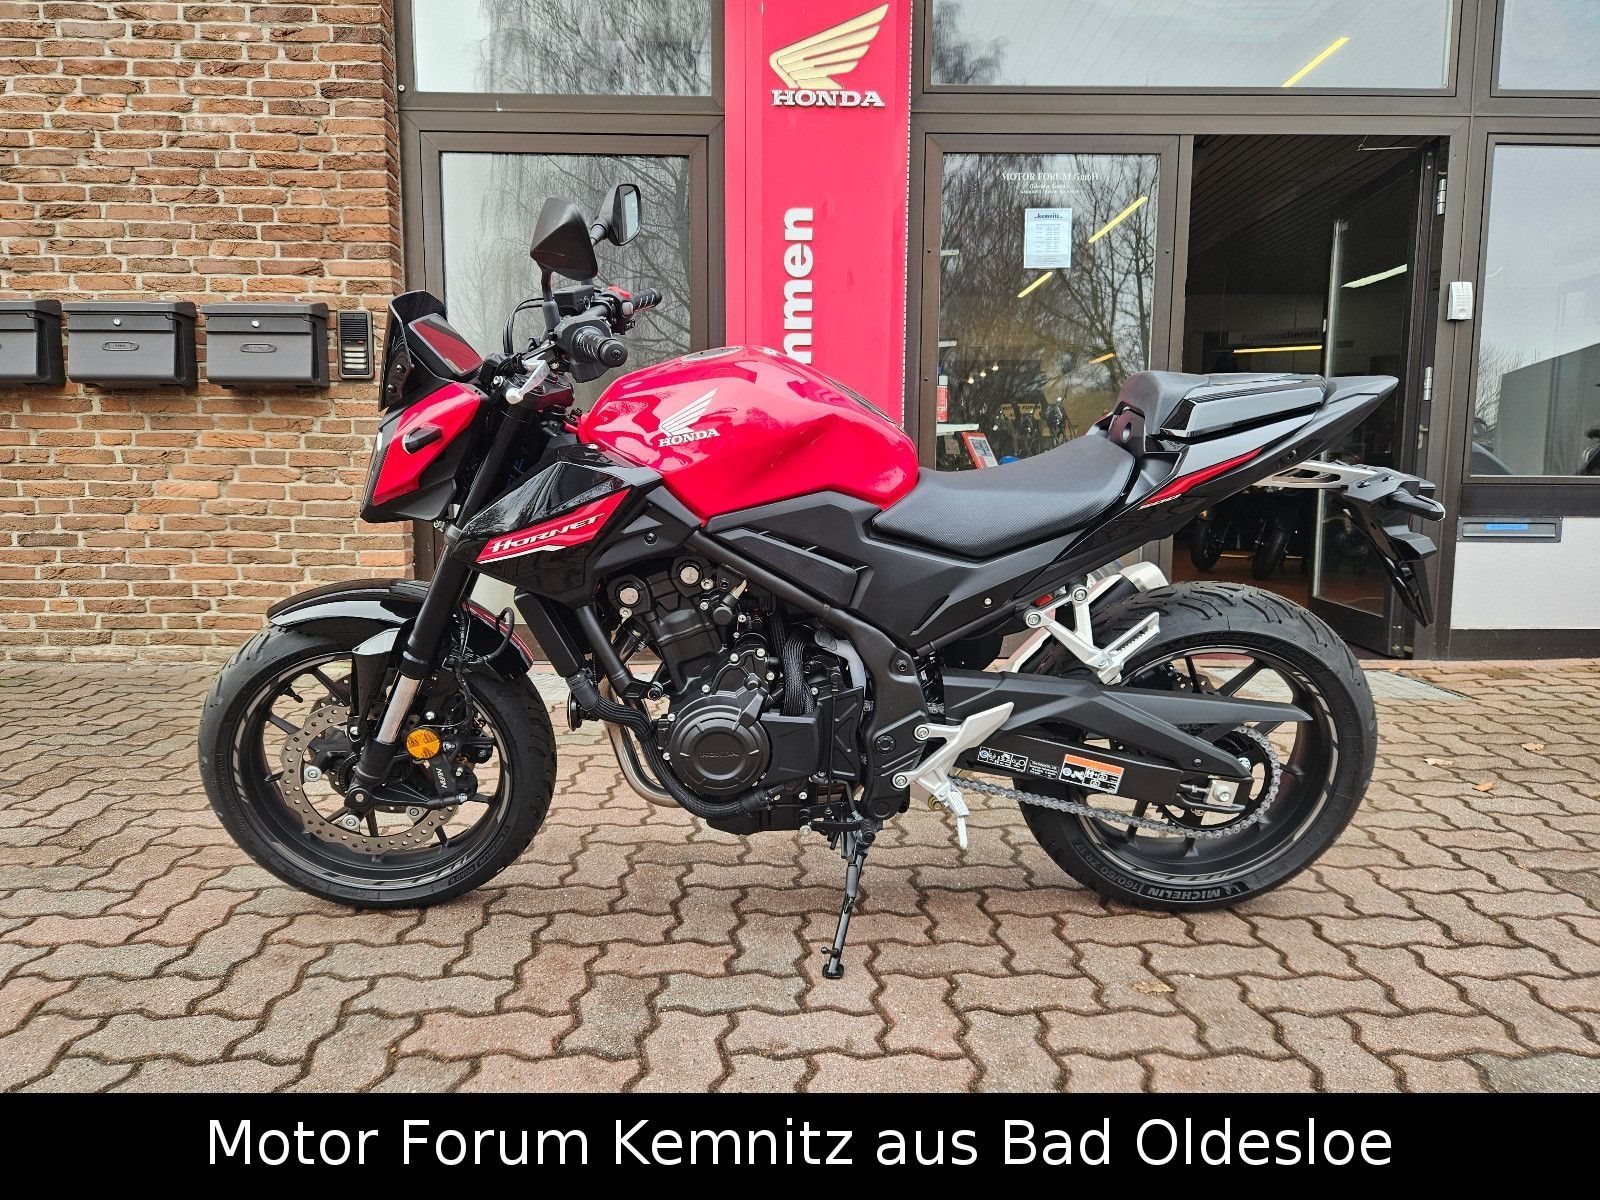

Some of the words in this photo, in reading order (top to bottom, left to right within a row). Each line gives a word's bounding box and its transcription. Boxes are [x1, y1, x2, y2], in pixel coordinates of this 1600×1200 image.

[771, 89, 886, 107] HONDA
[1002, 172, 1035, 181] MOTOR
[1038, 172, 1071, 181] FORUM
[1073, 172, 1099, 181] GmbH
[1241, 329, 1320, 341] Kundendienst
[658, 428, 720, 447] HONDA
[487, 513, 606, 553] HORNET
[1148, 886, 1221, 900] MICHELIN
